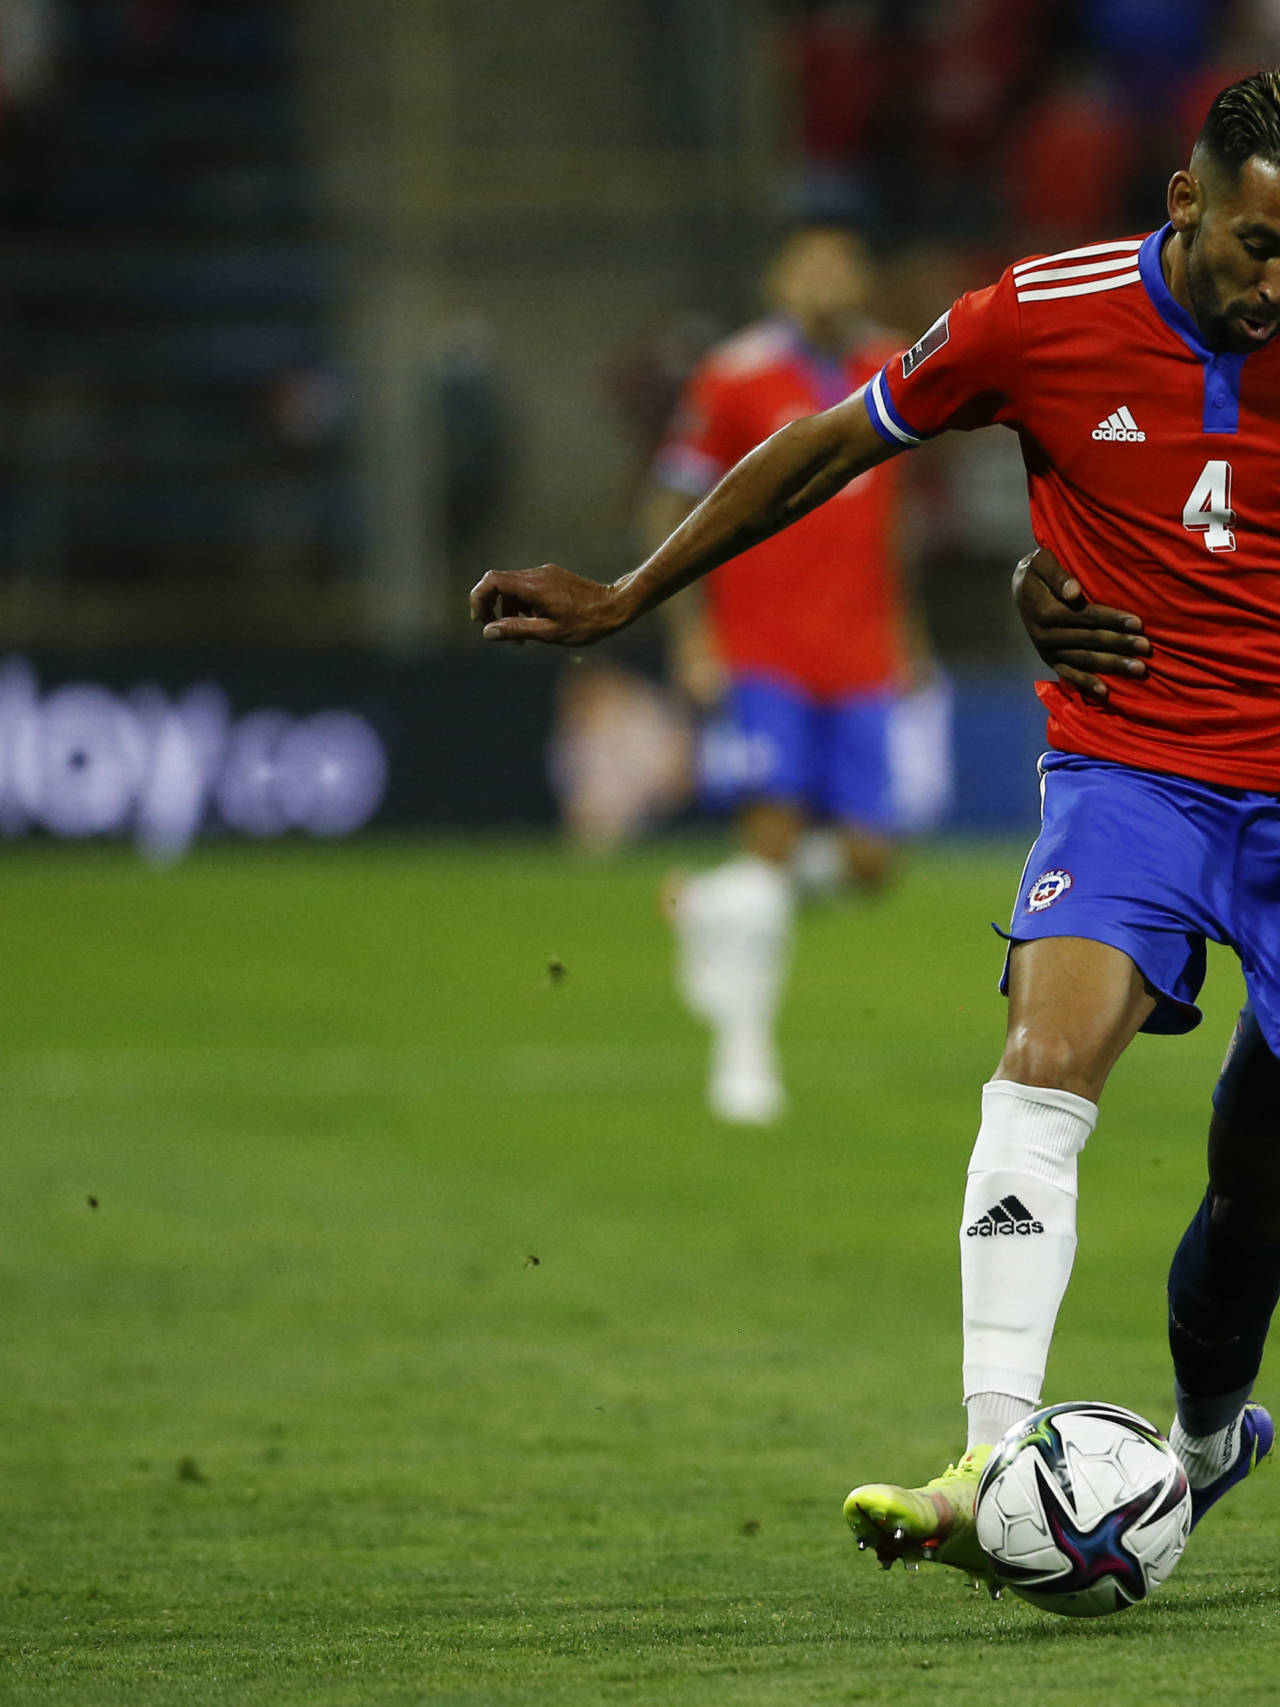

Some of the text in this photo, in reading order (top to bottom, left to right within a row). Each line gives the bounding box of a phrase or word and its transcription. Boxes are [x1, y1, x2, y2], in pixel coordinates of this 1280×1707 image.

[1091, 427, 1146, 442] adidas
[1182, 459, 1237, 553] 4
[966, 1220, 1044, 1237] adidas
